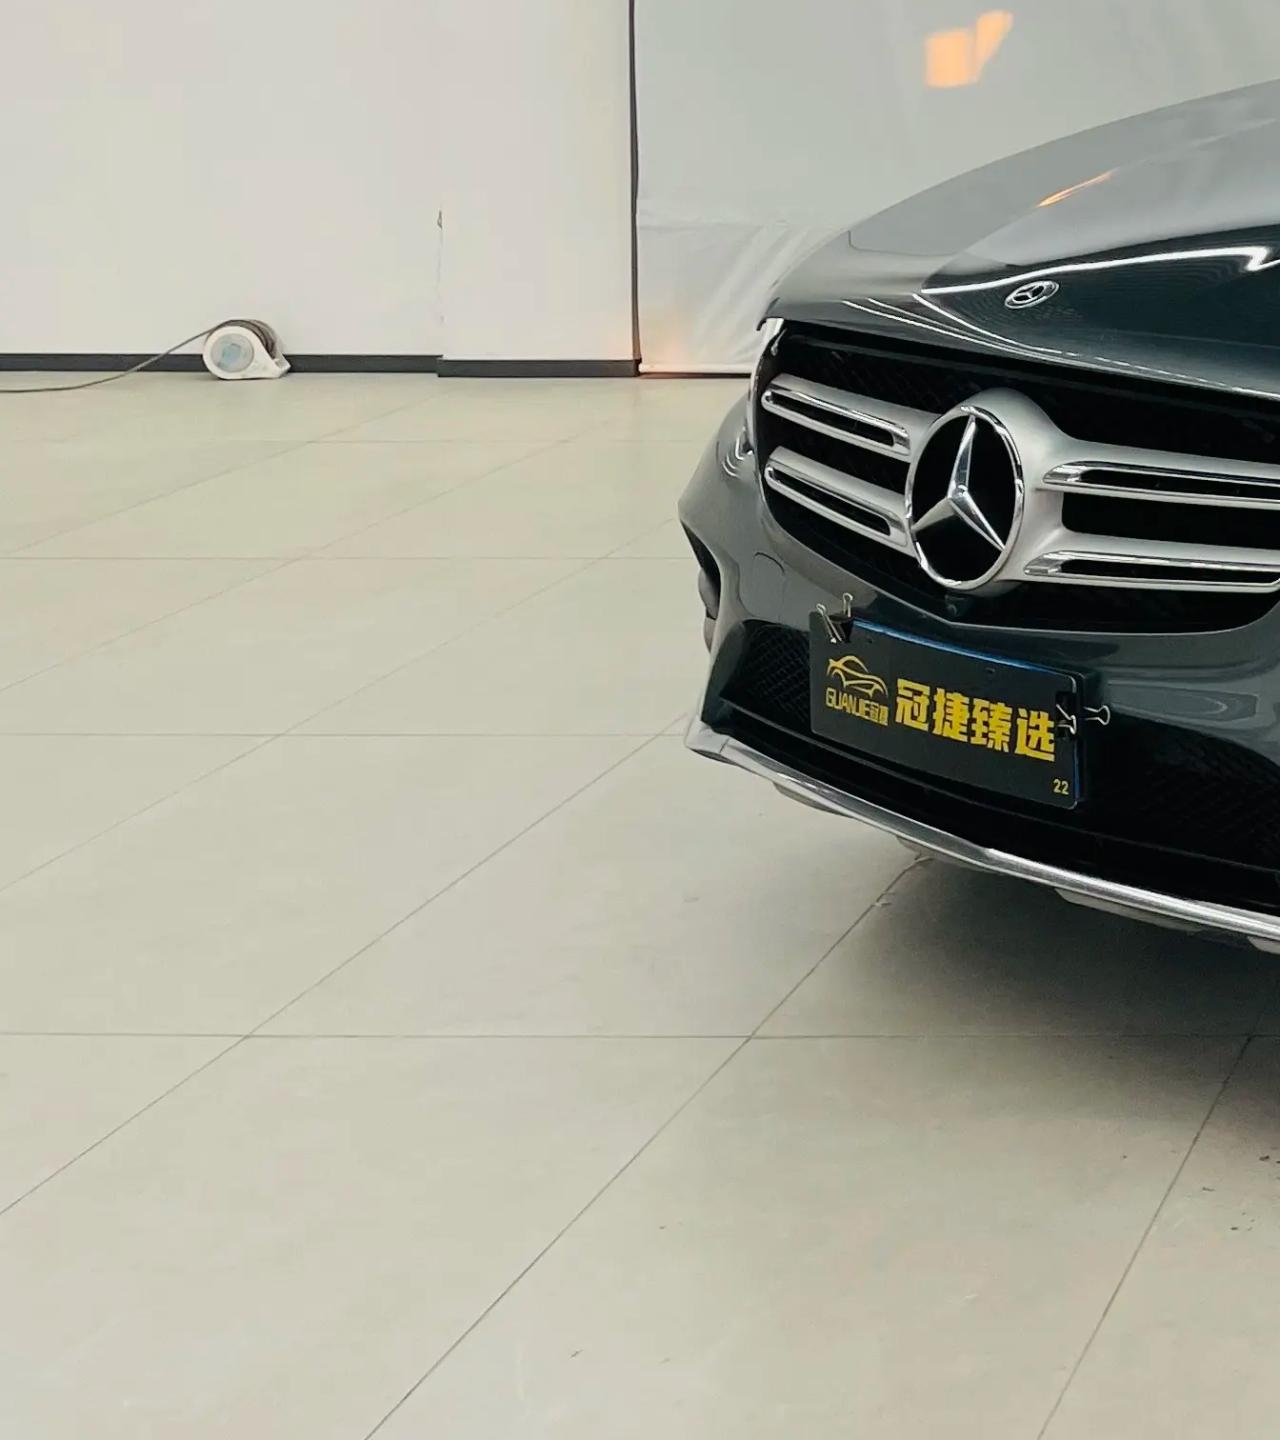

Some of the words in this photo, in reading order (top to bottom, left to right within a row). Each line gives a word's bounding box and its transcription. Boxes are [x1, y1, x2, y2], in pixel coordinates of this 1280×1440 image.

[894, 678, 1056, 762] 冠捷臻选
[1053, 778, 1070, 795] 22
